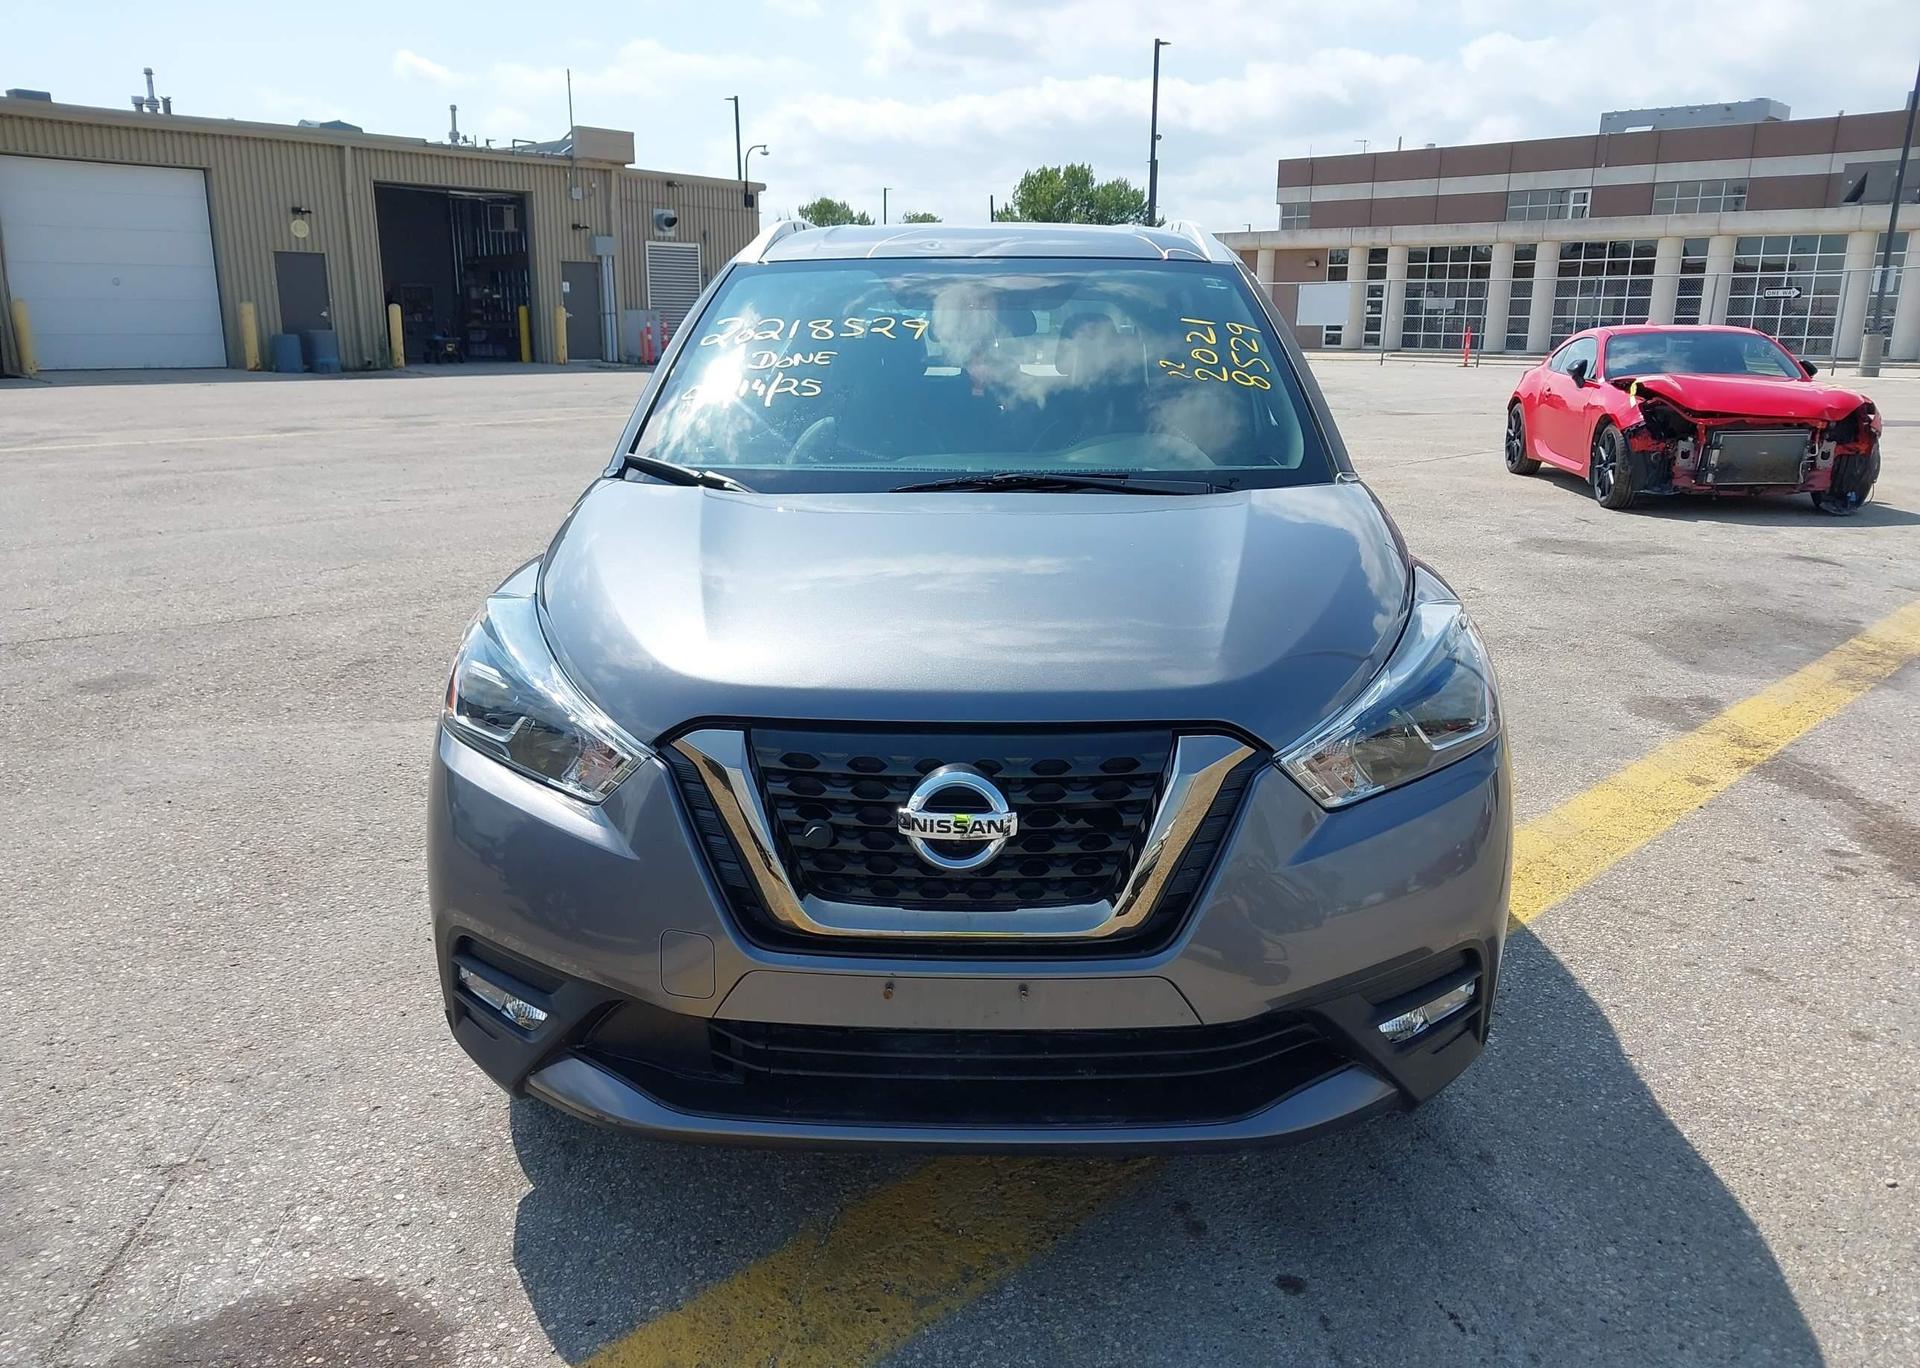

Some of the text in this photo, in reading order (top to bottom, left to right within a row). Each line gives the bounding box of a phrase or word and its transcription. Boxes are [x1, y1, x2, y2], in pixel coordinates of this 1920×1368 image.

[1180, 317, 1229, 382] 2021
[1225, 322, 1271, 390] 8529
[911, 817, 1004, 835] NISSAN
